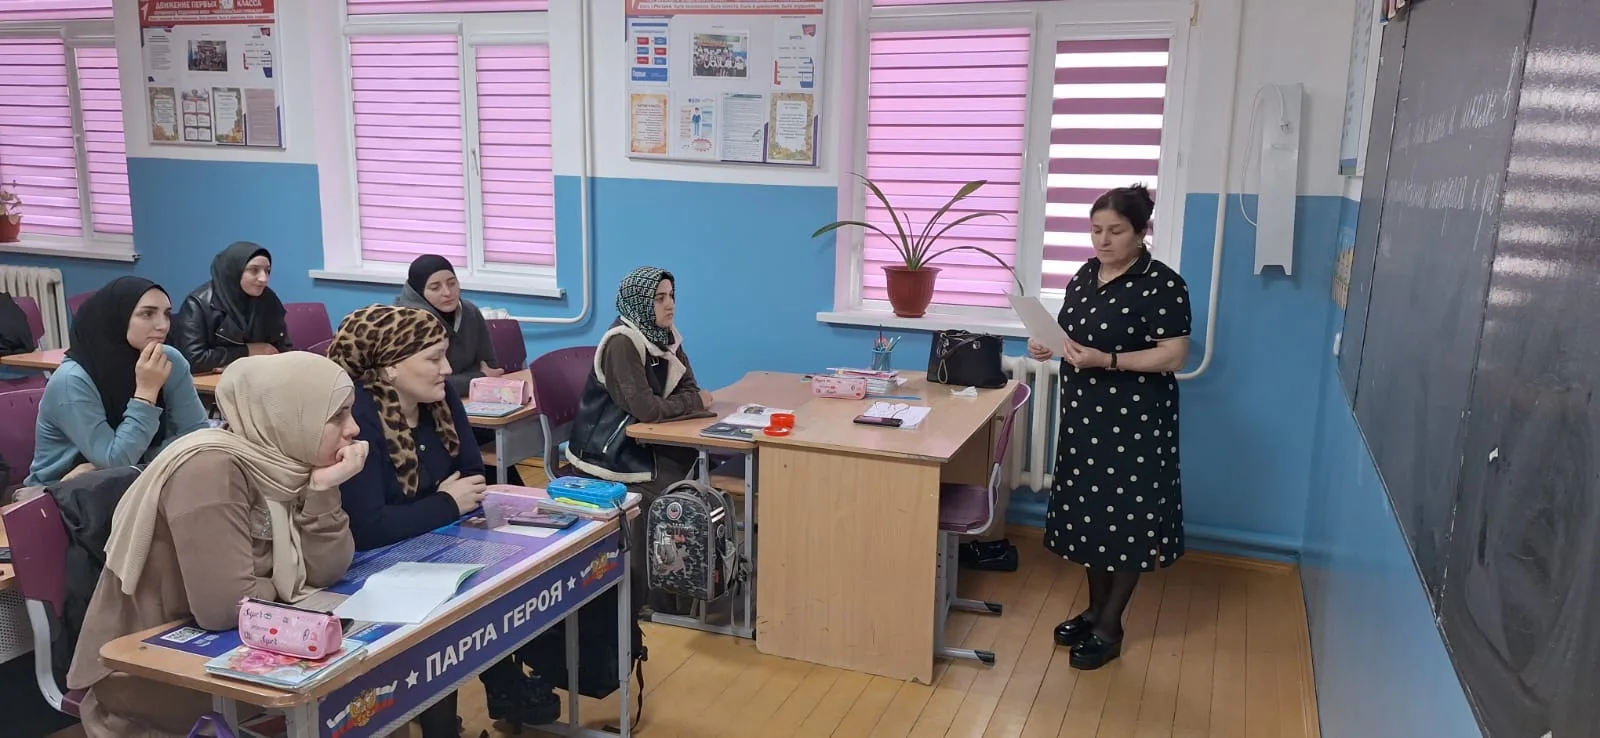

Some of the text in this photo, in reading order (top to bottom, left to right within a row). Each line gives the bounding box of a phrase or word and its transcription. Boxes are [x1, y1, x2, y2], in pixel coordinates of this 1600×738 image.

[155, 1, 190, 9] ДВИЖЕНИЕ
[191, 0, 217, 8] ПЕРВЫХ
[426, 579, 562, 682] ПАРТА ГЕРОЯ
